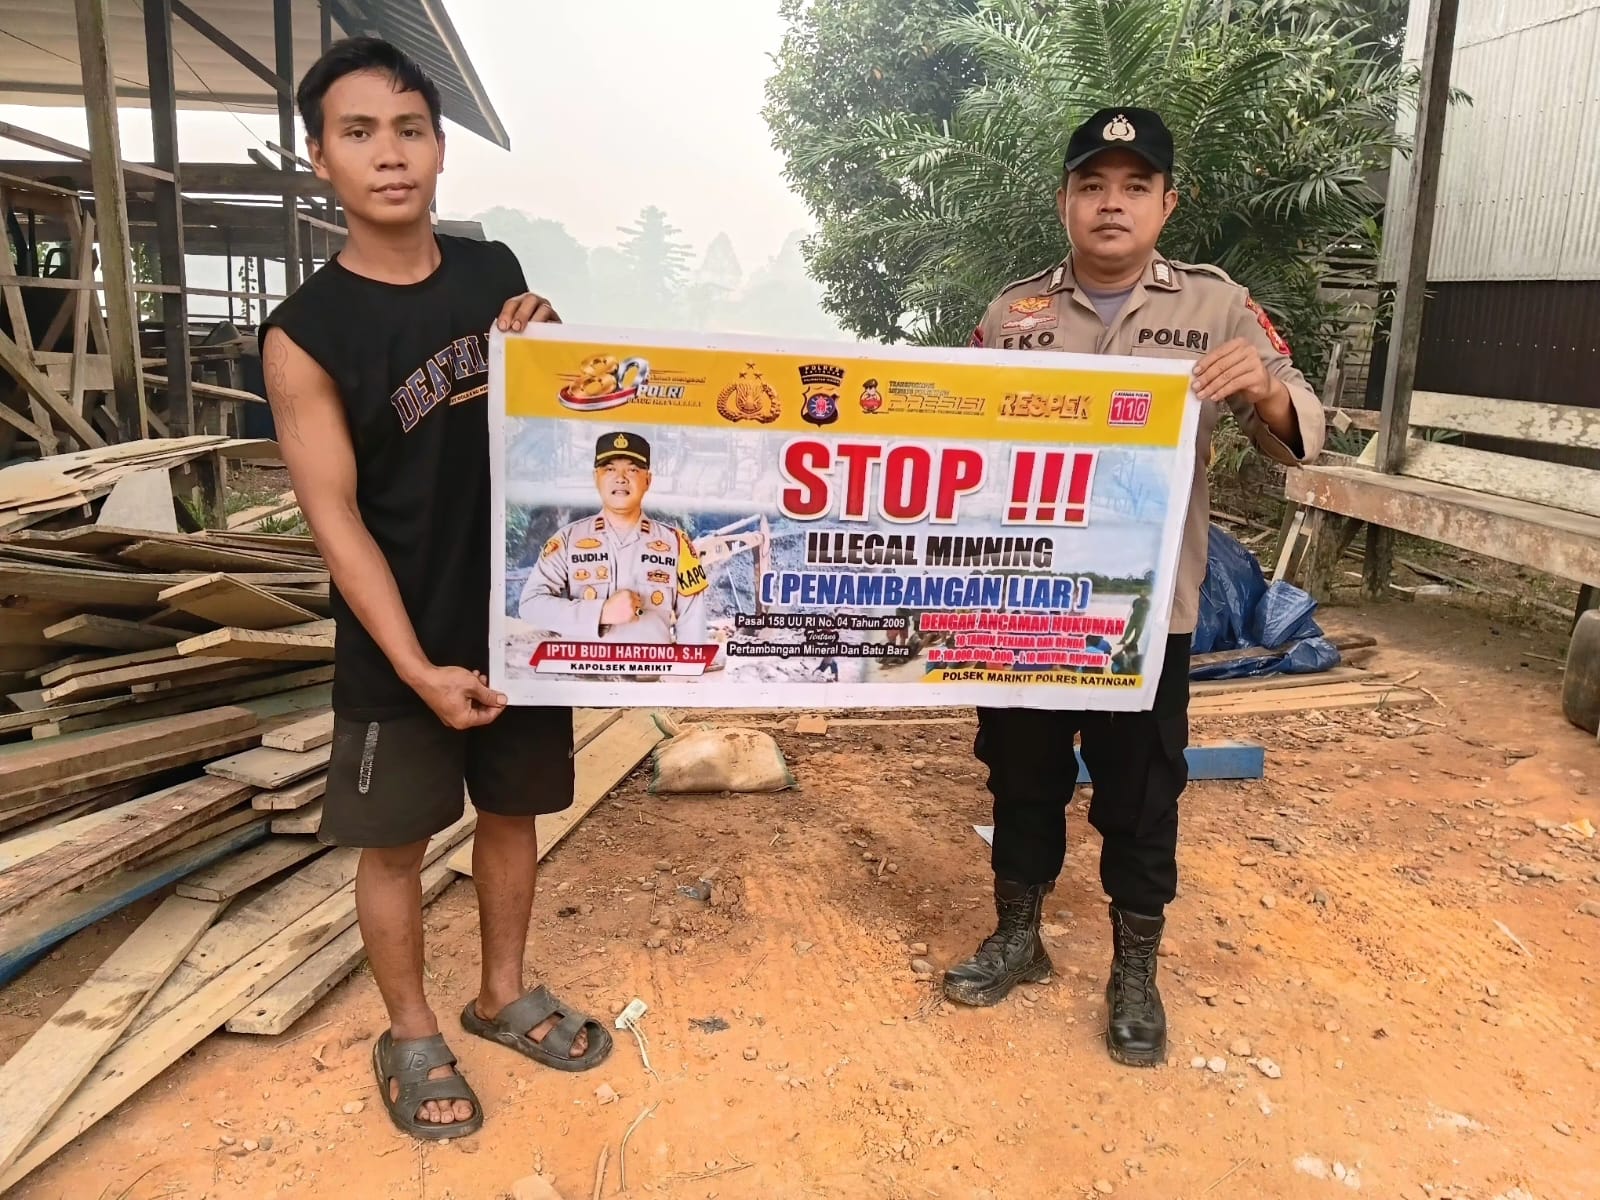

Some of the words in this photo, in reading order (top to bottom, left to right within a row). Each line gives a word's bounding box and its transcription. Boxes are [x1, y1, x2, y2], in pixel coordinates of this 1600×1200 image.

[1003, 331, 1055, 349] EKO
[1138, 328, 1209, 351] POLRI
[390, 333, 489, 433] DEATHL
[636, 384, 684, 399] POLRI
[1000, 392, 1092, 420] RESPEK
[1113, 399, 1147, 420] 110
[781, 439, 986, 521] STOP
[1006, 450, 1095, 523] !!!
[571, 552, 609, 564] BUDI.H
[807, 531, 918, 567] ILLEGAL
[924, 535, 1054, 569] MINNING
[641, 554, 676, 567] POLRI
[780, 573, 1002, 608] PENAMBANGAN
[1005, 577, 1073, 609] LIAR
[738, 615, 765, 626] Pasal
[768, 616, 785, 627] 158
[787, 616, 803, 627] UU
[805, 616, 816, 627] RI
[818, 617, 835, 628] No.
[837, 617, 848, 628] 04
[851, 617, 880, 628] Tahun
[882, 618, 905, 628] 2009
[919, 613, 977, 632] DENGAN
[978, 614, 1050, 634] ANCAMAN
[1051, 616, 1126, 636] HUKUMAN
[807, 630, 837, 642] Tentang
[547, 644, 576, 658] IPTU
[580, 644, 611, 658] BUDI
[615, 645, 678, 661] HARTONO,
[682, 646, 707, 660] S.H.
[729, 644, 801, 657] Pertambangan
[803, 644, 838, 655] Mineral
[840, 645, 860, 656] Dan
[862, 645, 885, 656] Batu
[887, 645, 910, 656] Bara
[570, 662, 626, 671] KAPOLSEK
[629, 663, 672, 672] MARIKIT
[942, 671, 984, 681] POLSEK
[987, 672, 1032, 683] MARIKIT
[1035, 674, 1078, 684] POLRES
[1080, 676, 1137, 687] KATINGAN
